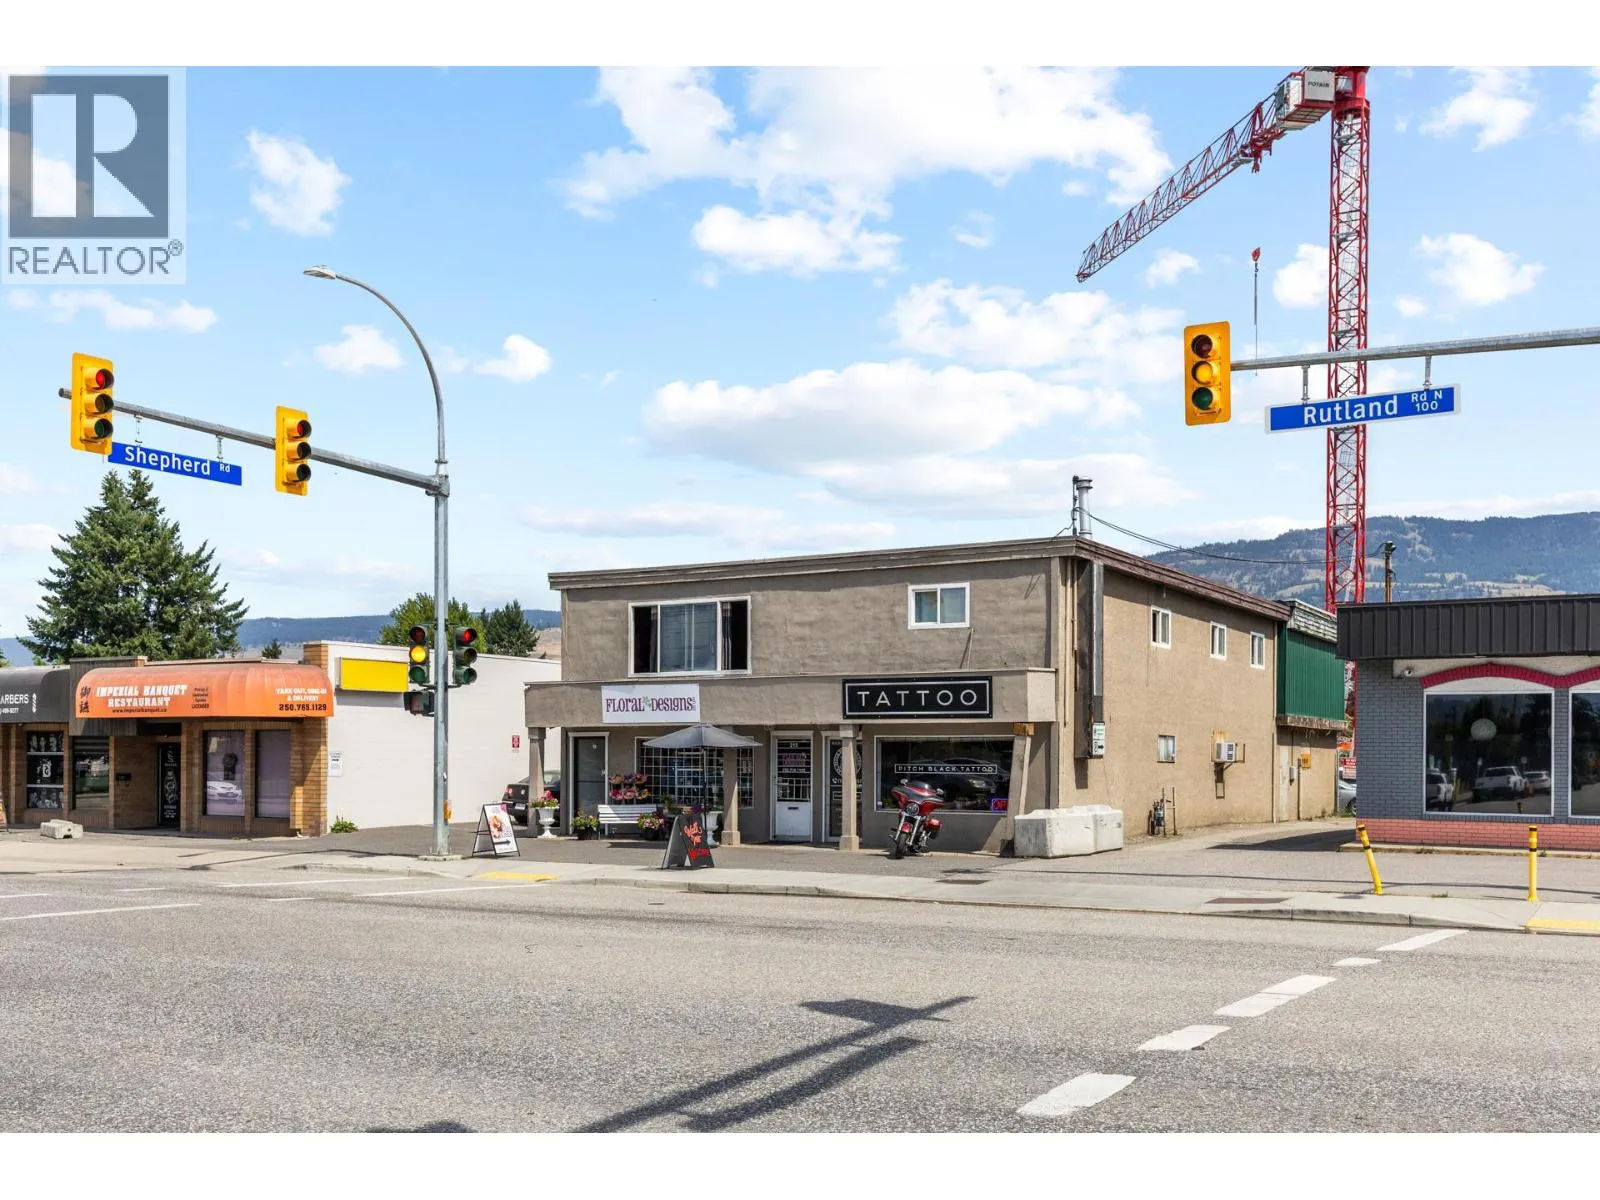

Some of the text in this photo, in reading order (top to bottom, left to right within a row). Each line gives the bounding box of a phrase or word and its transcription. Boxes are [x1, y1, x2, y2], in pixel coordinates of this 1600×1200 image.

[1303, 390, 1443, 425] Rutland Rd N
[1415, 401, 1438, 412] 100
[125, 446, 231, 475] Shepherd Rd
[96, 685, 139, 697] IMPERIAL
[143, 684, 188, 696] BANQUET
[0, 694, 29, 704] ARBERS
[107, 696, 171, 707] RESTAURANT
[857, 689, 977, 707] TATTOO
